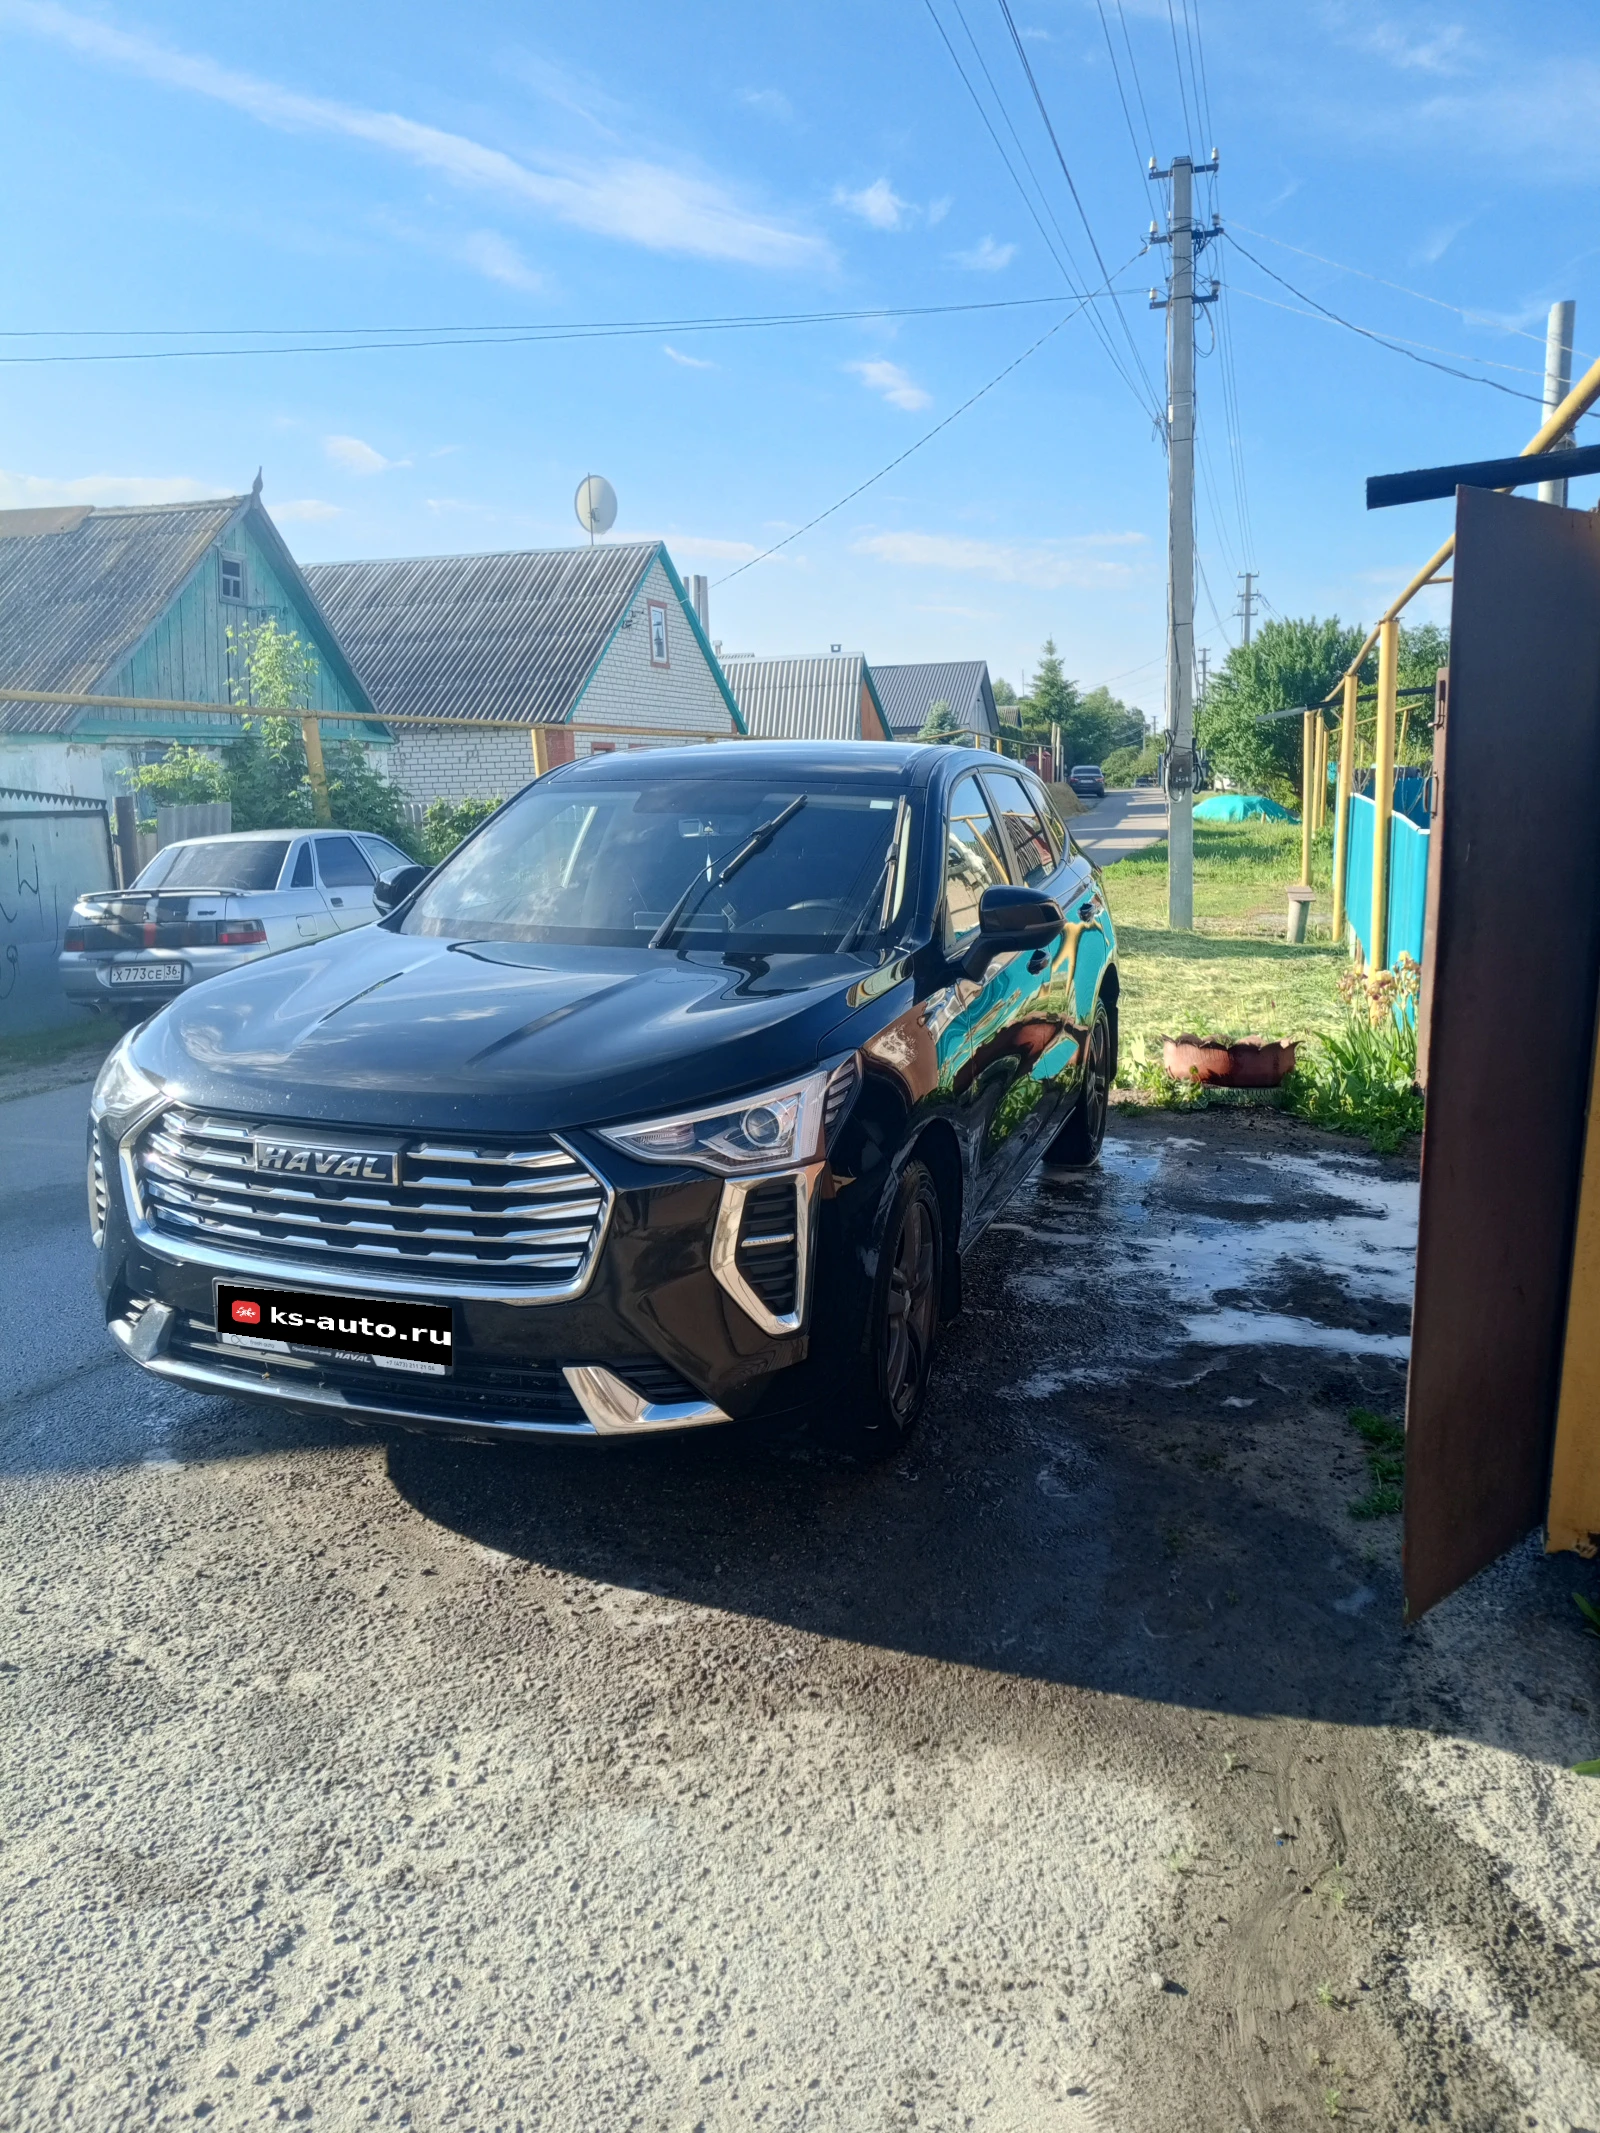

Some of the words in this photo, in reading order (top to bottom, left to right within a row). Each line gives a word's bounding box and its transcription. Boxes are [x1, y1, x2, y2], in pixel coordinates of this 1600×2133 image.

[166, 966, 178, 975] 36
[262, 1147, 387, 1179] HAVAL
[335, 1352, 371, 1363] HAVAL
